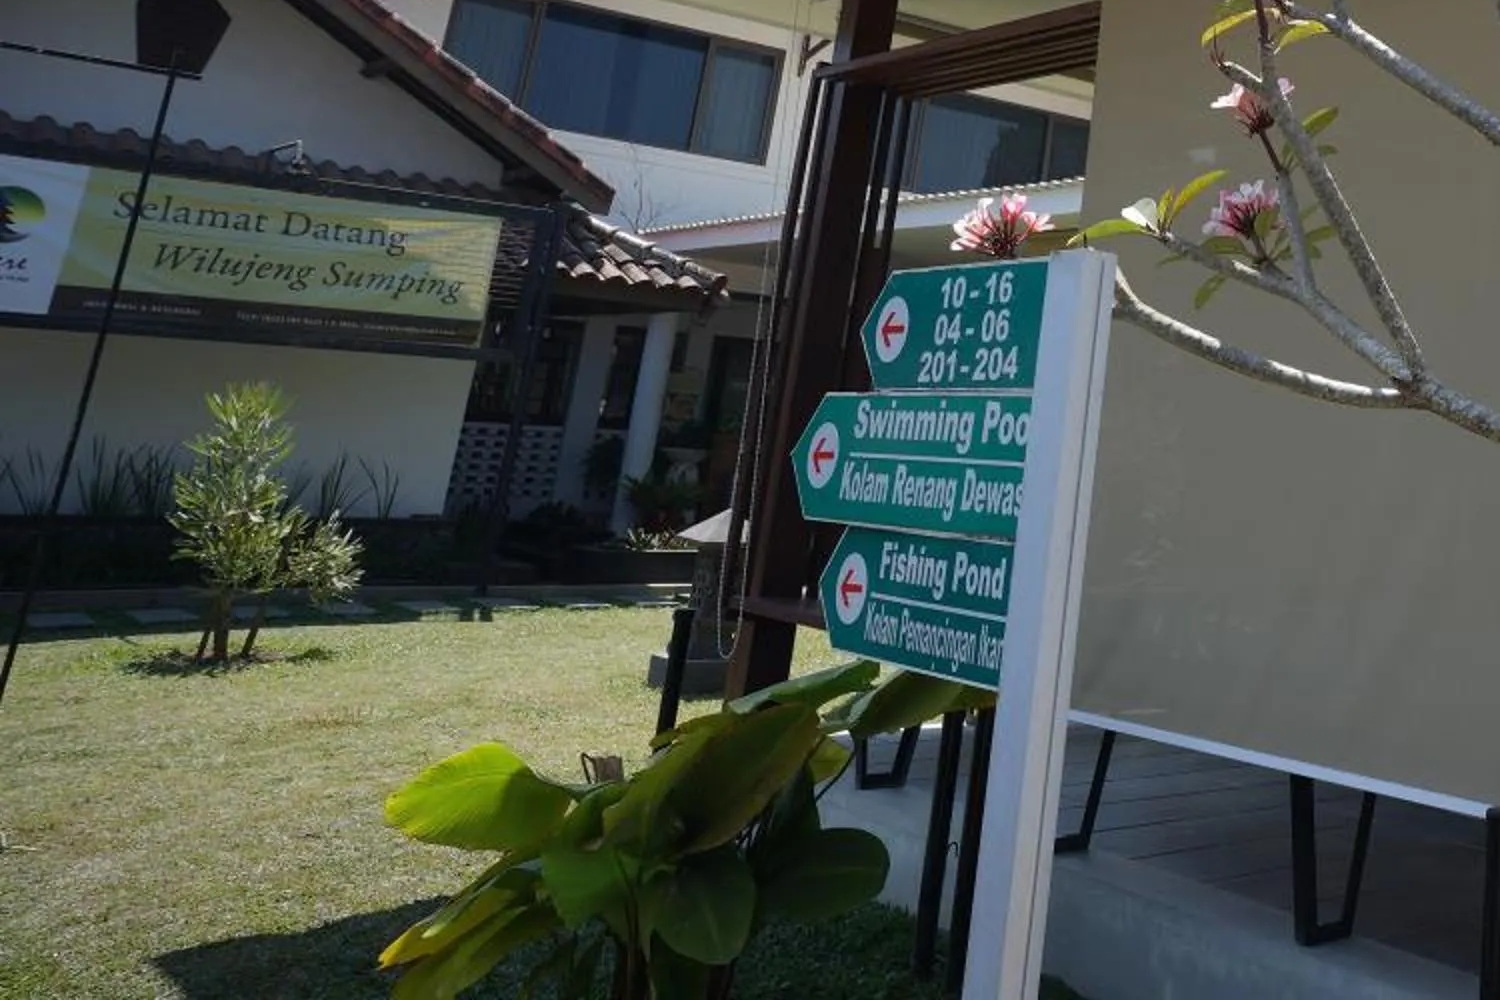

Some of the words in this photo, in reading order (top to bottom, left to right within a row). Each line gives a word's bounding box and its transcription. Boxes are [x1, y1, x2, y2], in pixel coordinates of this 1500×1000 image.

[113, 191, 269, 233] Selamat
[281, 211, 409, 257] Datang
[153, 243, 316, 292] Wilujeng
[322, 262, 464, 304] Sumping
[941, 276, 967, 309] 10
[985, 271, 1014, 305] 16
[934, 312, 962, 345] 04
[981, 309, 1011, 342] 06
[854, 400, 975, 454] Swimming
[981, 401, 1030, 446] Poo
[839, 461, 889, 505] Kolam
[891, 463, 958, 522] Renang
[960, 468, 1024, 517] Dewas
[879, 541, 948, 600] Fishing
[952, 551, 1007, 600] Pond
[864, 602, 898, 647] Kolam
[898, 608, 976, 673] Pemancingan
